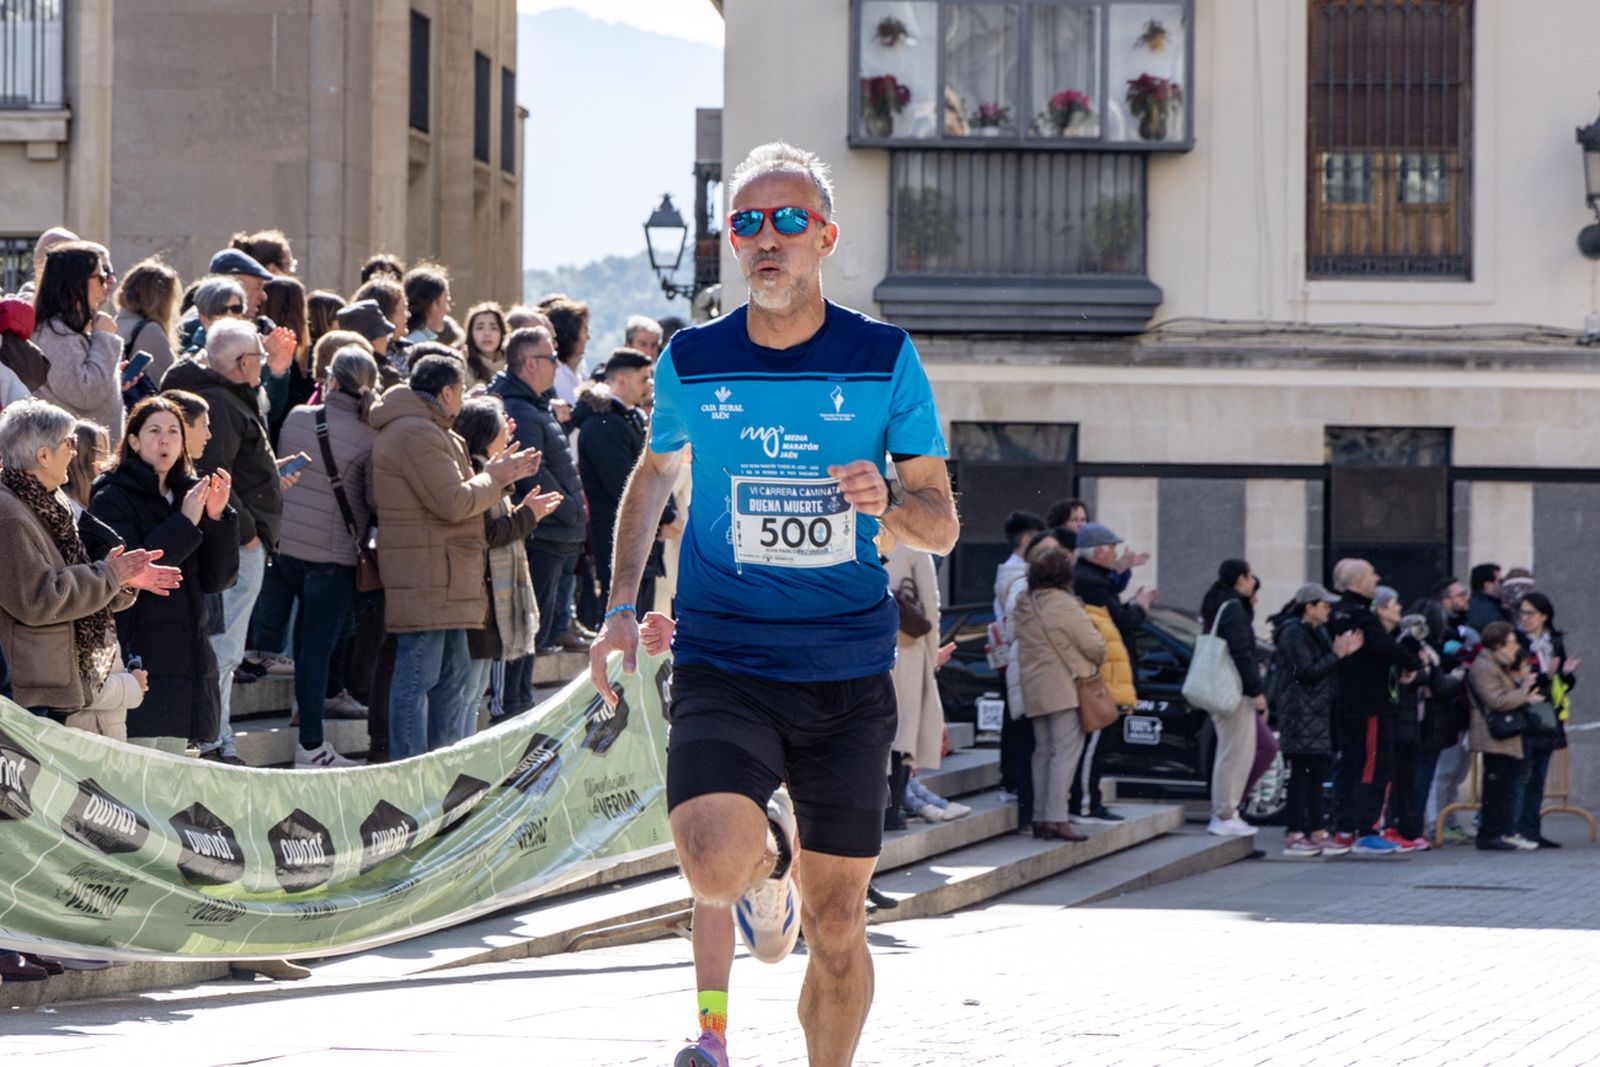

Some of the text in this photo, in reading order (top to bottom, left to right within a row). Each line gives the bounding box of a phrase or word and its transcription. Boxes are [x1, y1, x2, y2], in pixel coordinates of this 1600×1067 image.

[719, 404, 744, 412] RURAL
[780, 450, 799, 459] JAÉN
[782, 442, 819, 451] MARATÓN
[749, 486, 758, 494] VI
[760, 486, 798, 496] CARRERA
[749, 498, 823, 513] BUENA MUERTE
[760, 517, 832, 548] 500
[83, 793, 138, 836] ownat
[184, 829, 235, 860] ownat
[280, 832, 326, 865] ownat
[371, 820, 410, 857] ownat
